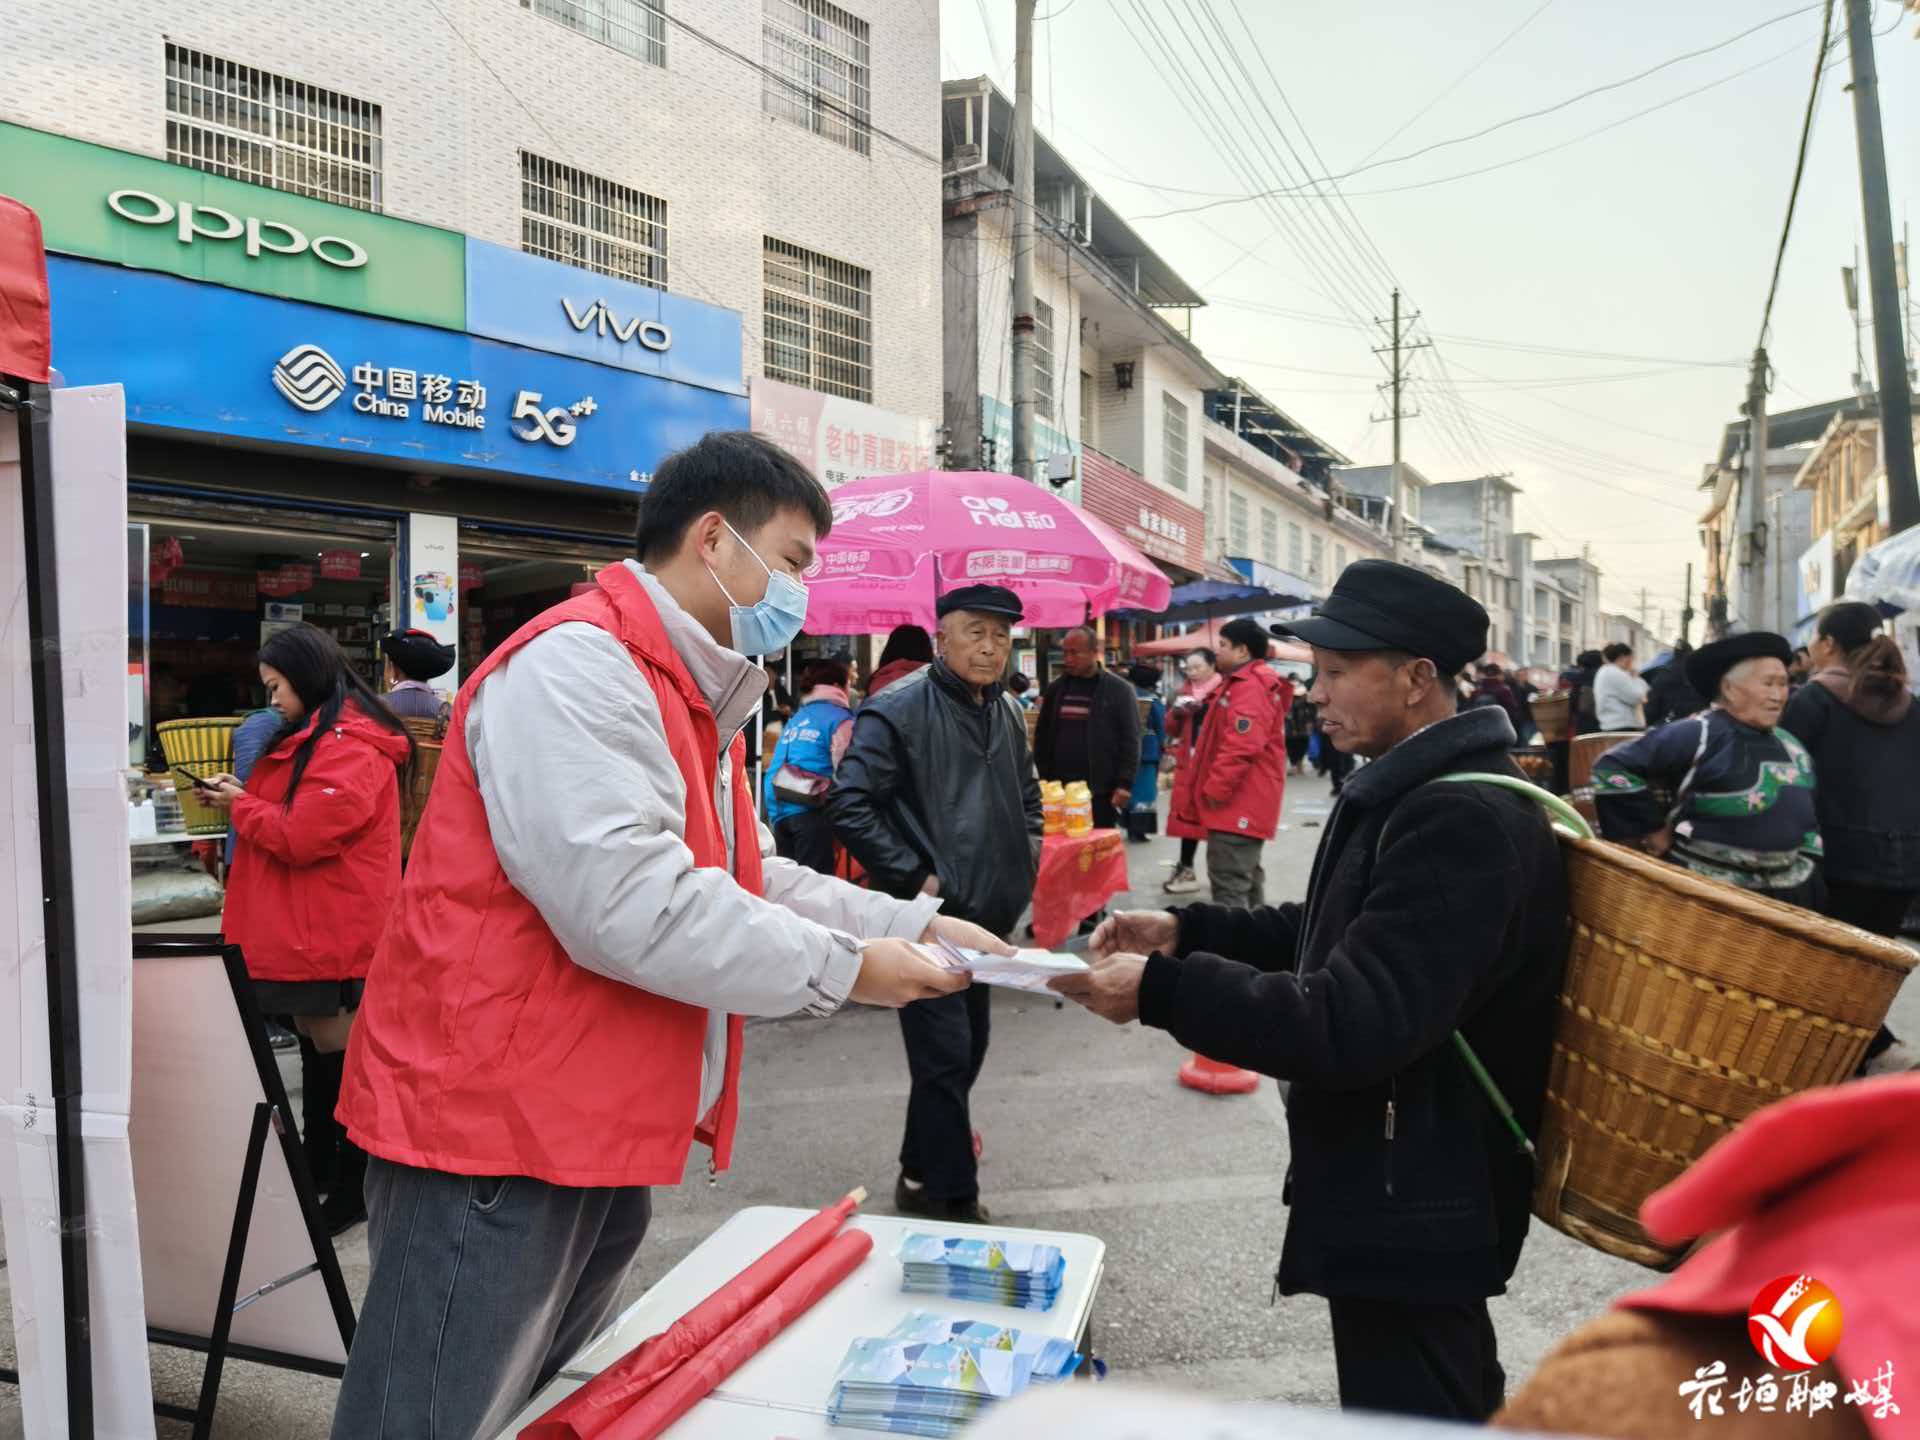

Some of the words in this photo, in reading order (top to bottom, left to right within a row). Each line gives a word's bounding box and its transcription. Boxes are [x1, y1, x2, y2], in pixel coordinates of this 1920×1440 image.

[561, 297, 673, 353] vivo
[351, 360, 487, 410] 中国移动
[353, 391, 410, 419] China
[422, 403, 487, 430] Mobile
